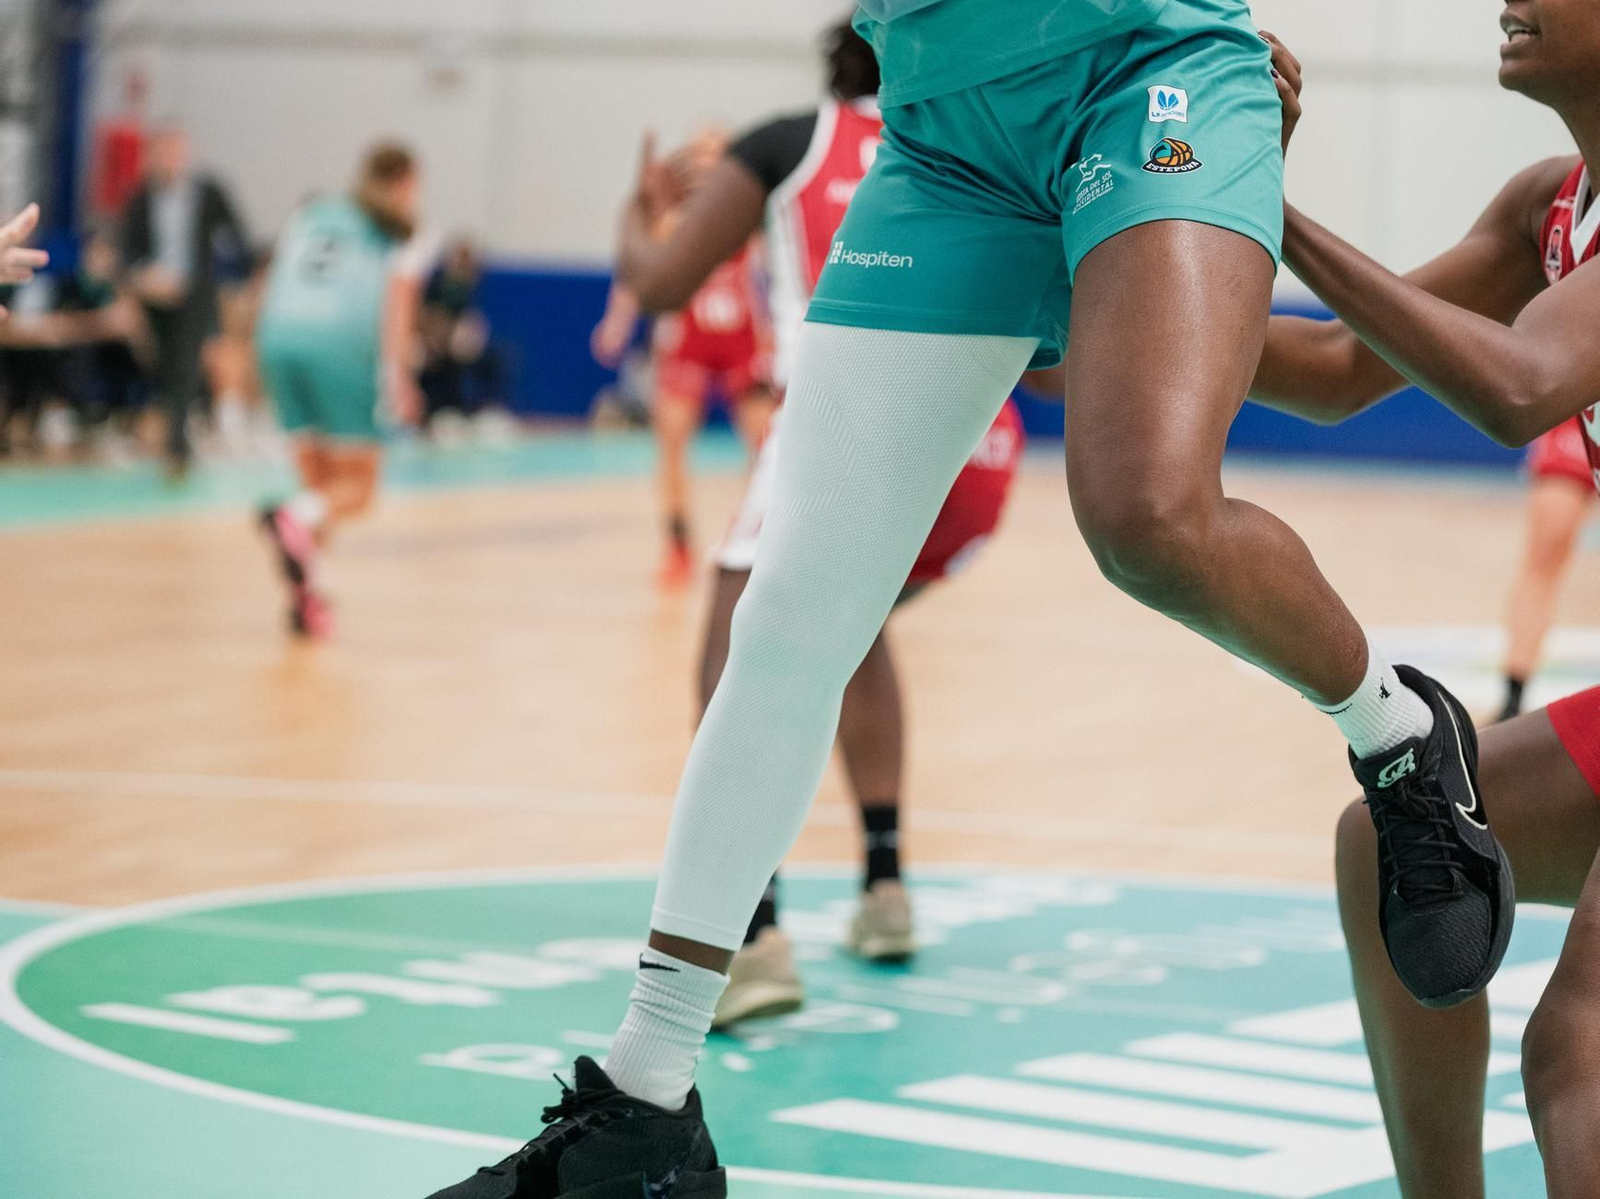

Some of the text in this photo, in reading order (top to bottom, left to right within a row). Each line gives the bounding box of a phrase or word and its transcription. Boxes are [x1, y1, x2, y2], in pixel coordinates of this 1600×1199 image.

[1145, 161, 1200, 173] ESTEPONA
[1101, 170, 1112, 184] SOL
[840, 248, 914, 270] Hospiten
